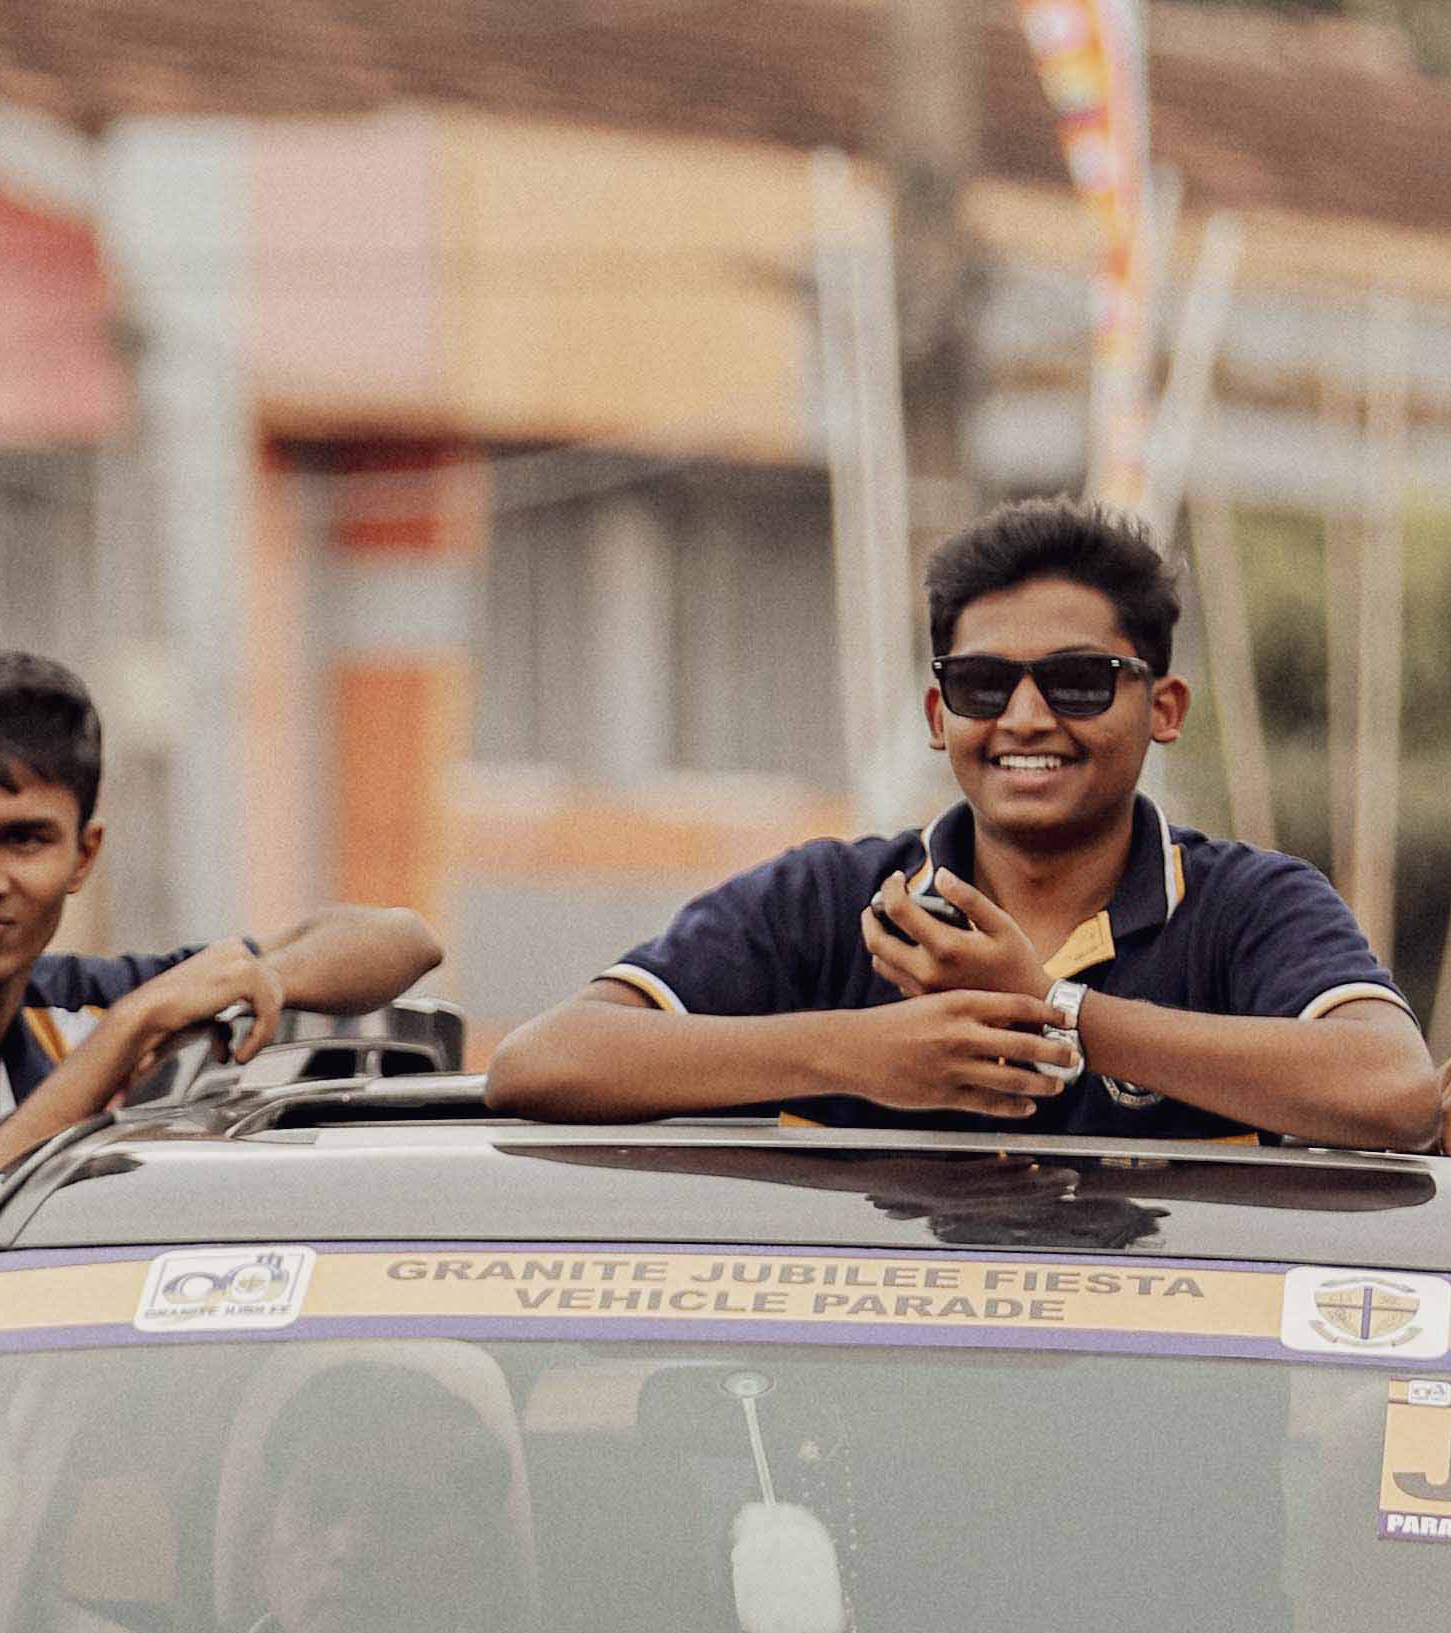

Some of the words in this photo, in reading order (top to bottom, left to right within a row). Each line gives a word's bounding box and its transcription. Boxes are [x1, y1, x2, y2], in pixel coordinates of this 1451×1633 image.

[386, 1260, 669, 1283] GRANITE
[692, 1260, 961, 1291] JUBILEE
[982, 1269, 1206, 1298] FIESTA
[515, 1288, 790, 1315] VEHICLE
[812, 1293, 1067, 1322] PARADE
